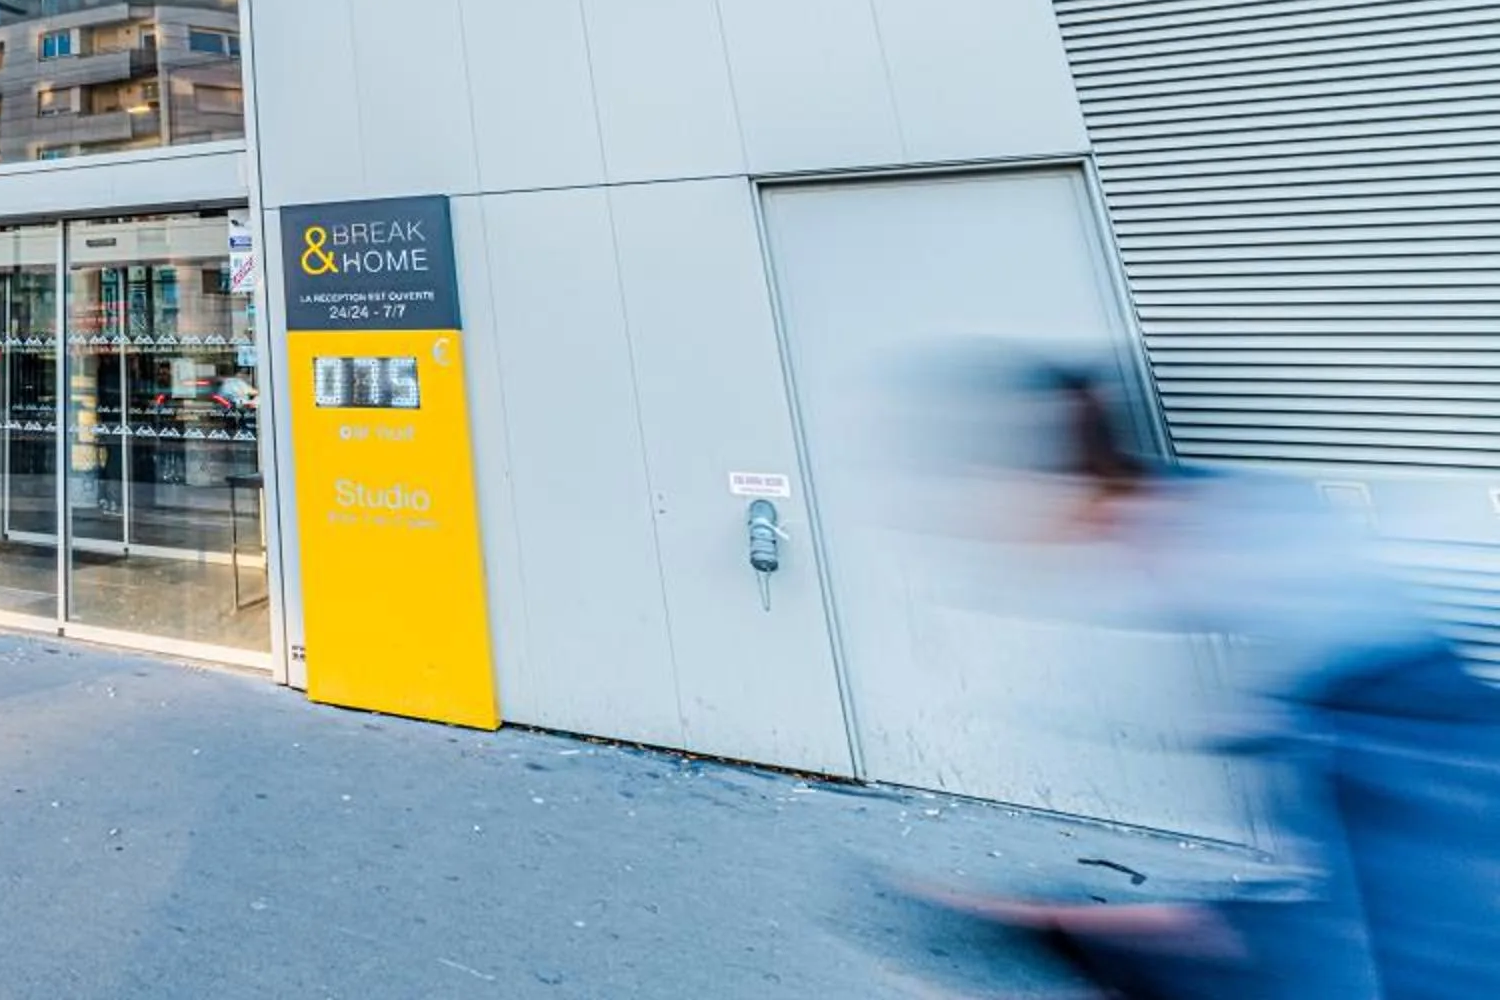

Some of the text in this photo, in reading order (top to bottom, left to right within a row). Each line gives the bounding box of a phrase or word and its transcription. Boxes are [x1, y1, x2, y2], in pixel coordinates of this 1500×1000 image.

[332, 219, 426, 246] BREAK
[301, 226, 339, 276] &
[342, 248, 429, 274] HOME
[328, 304, 369, 320] 24/24
[383, 303, 406, 318] 7/7
[334, 478, 432, 513] Studio
